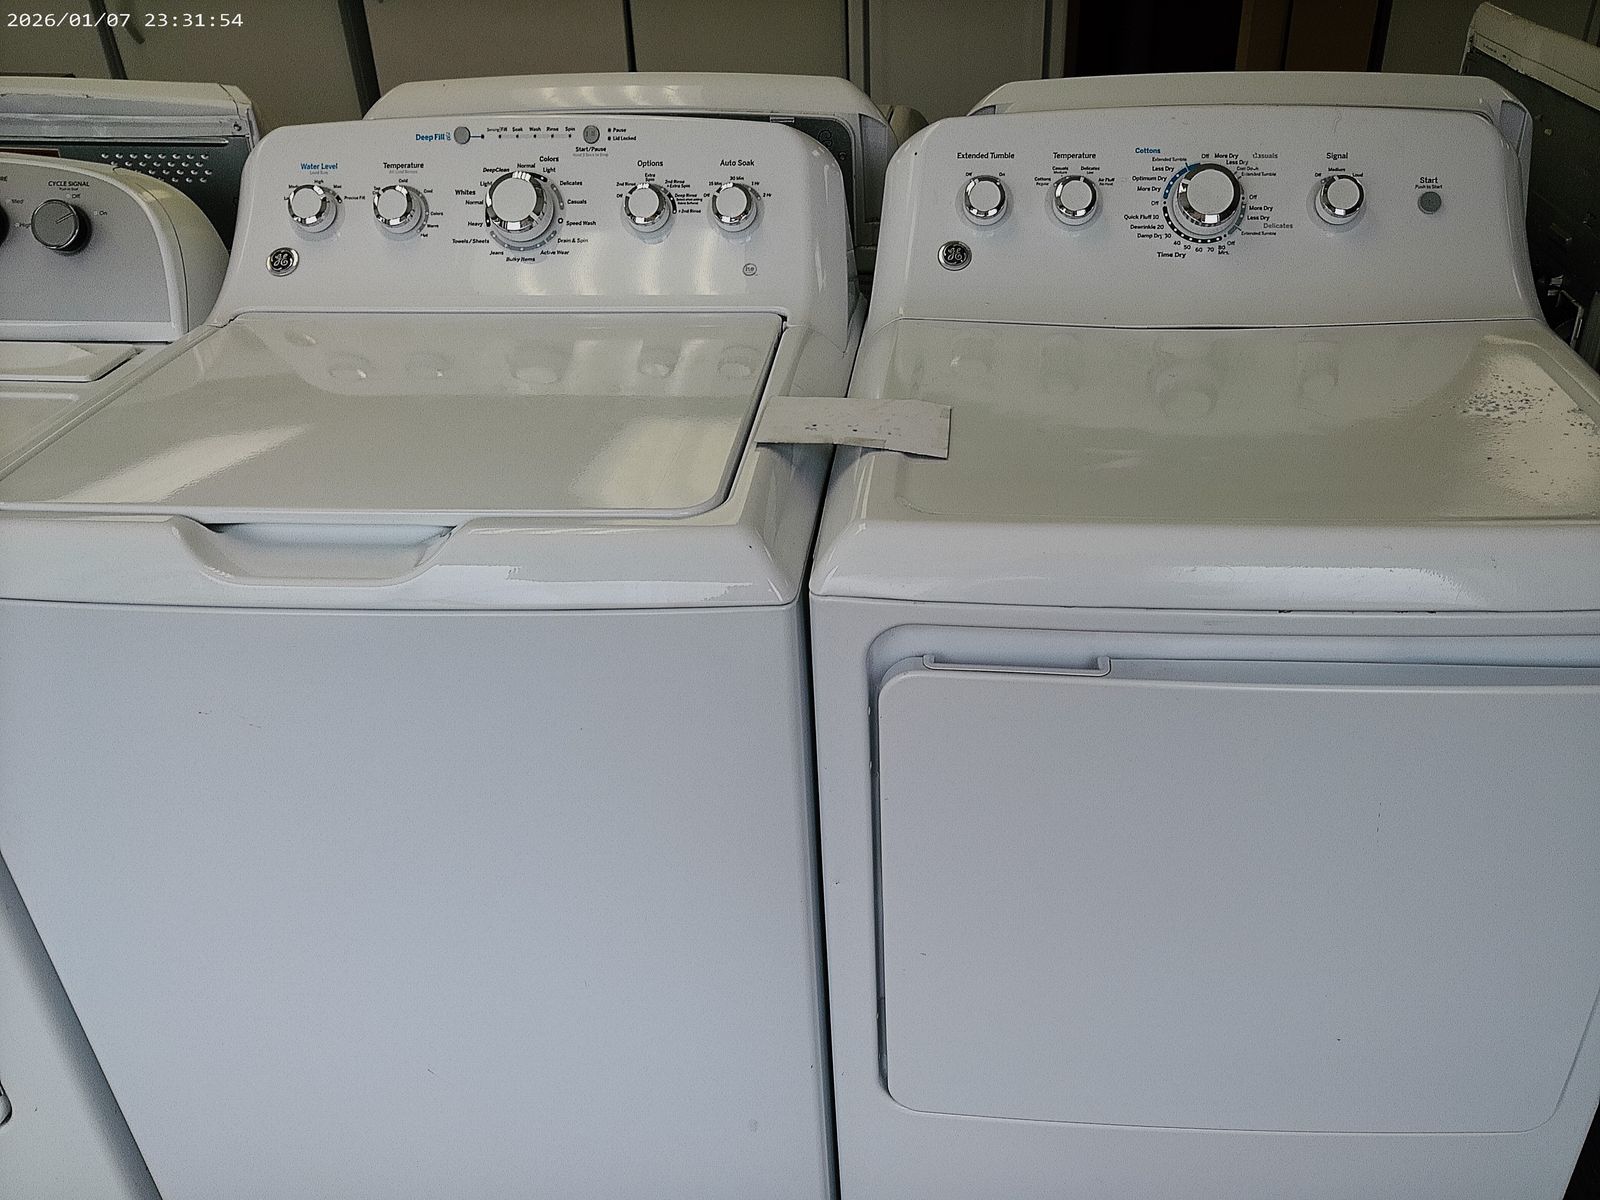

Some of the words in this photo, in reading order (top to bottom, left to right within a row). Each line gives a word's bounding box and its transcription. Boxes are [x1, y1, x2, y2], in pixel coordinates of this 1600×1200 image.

[1053, 152, 1096, 160] Temperature
[1326, 152, 1348, 160] Signal
[383, 162, 424, 170] Temperature
